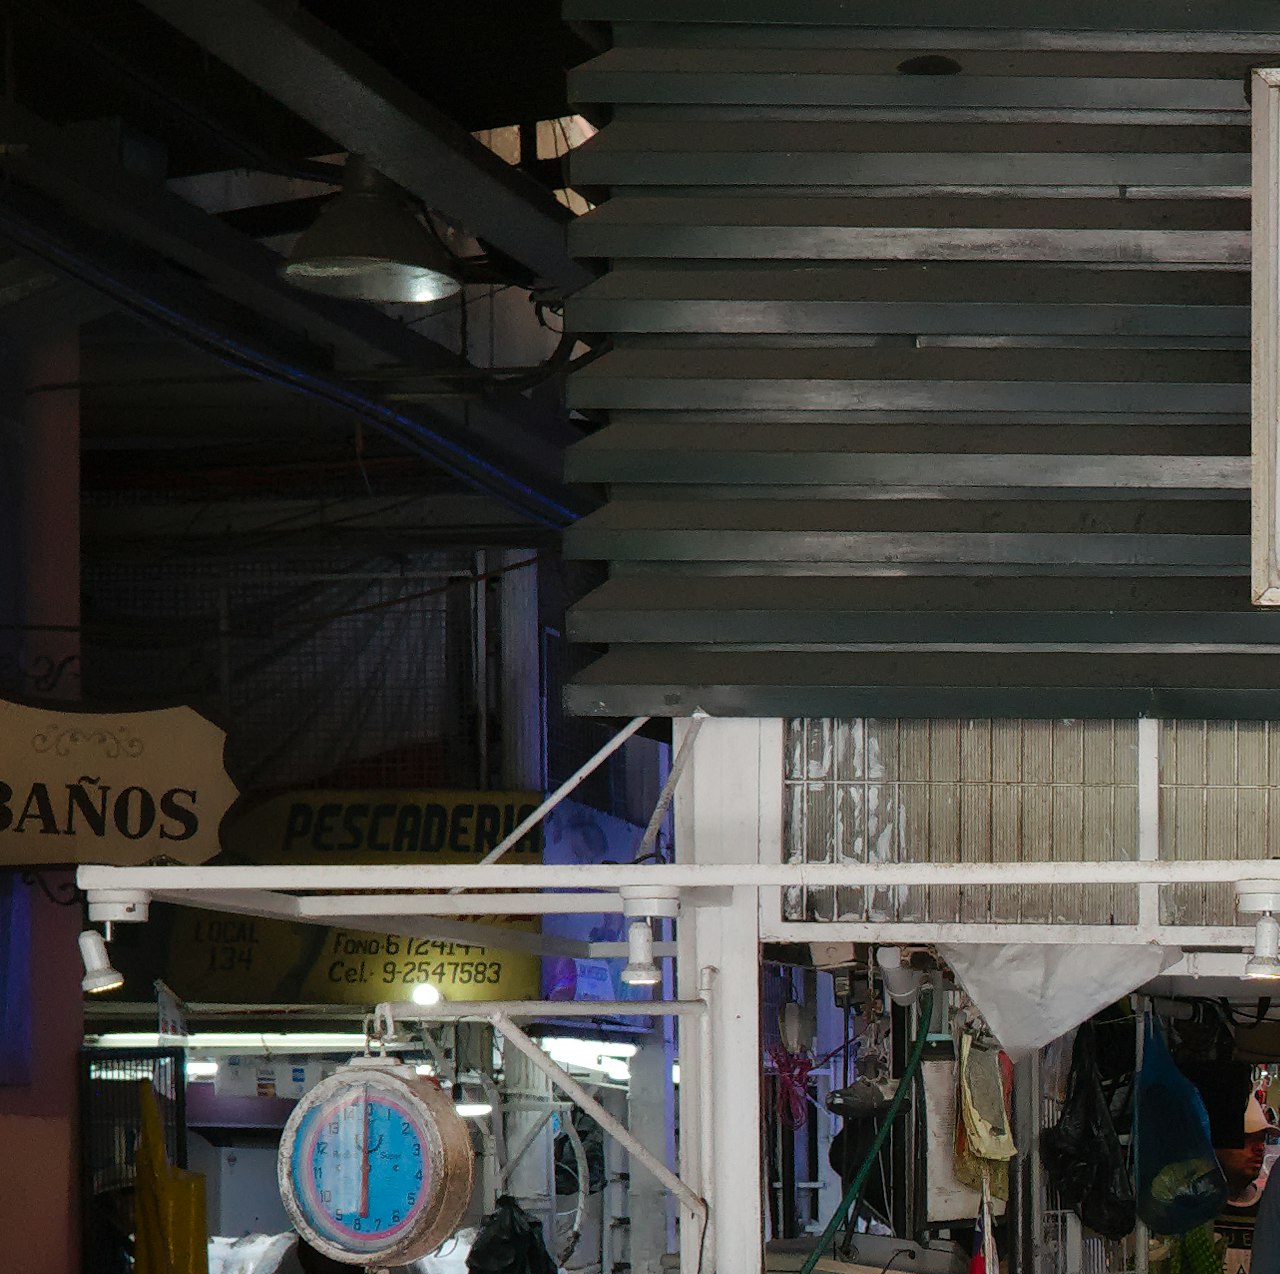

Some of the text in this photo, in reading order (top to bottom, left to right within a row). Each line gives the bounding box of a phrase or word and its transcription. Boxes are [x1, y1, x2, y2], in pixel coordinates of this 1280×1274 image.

[282, 804, 540, 853] PESCADERIA
[195, 921, 258, 944] LOCAL
[209, 948, 253, 971] 134
[383, 962, 502, 983] 9-2547583
[402, 1122, 410, 1136] 2
[413, 1144, 420, 1156] 3
[353, 1218, 361, 1231] 8
